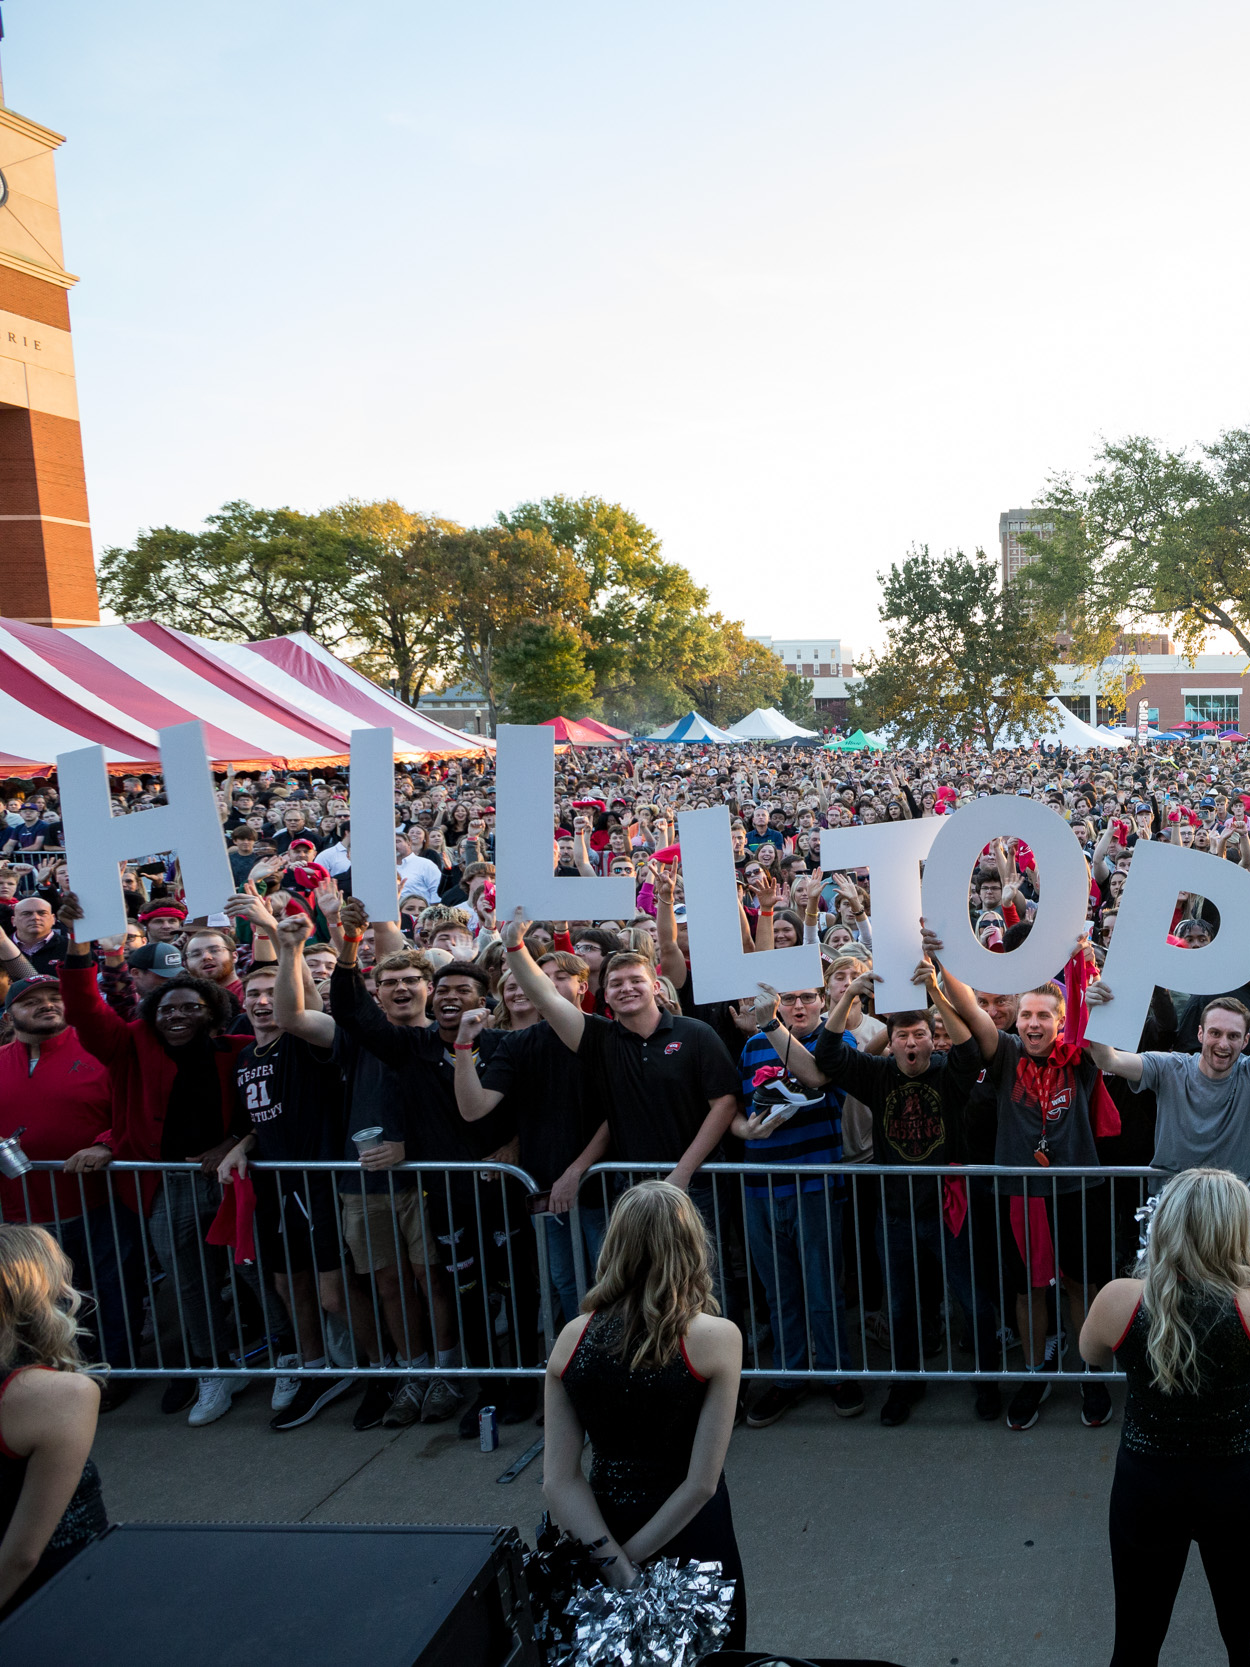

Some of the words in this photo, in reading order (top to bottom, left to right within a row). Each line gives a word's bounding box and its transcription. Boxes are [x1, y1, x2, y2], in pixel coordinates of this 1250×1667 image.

[1138, 700, 1149, 725] TOPS
[1138, 733, 1148, 746] GO
[246, 1080, 271, 1109] 21
[1051, 1095, 1066, 1106] WKU
